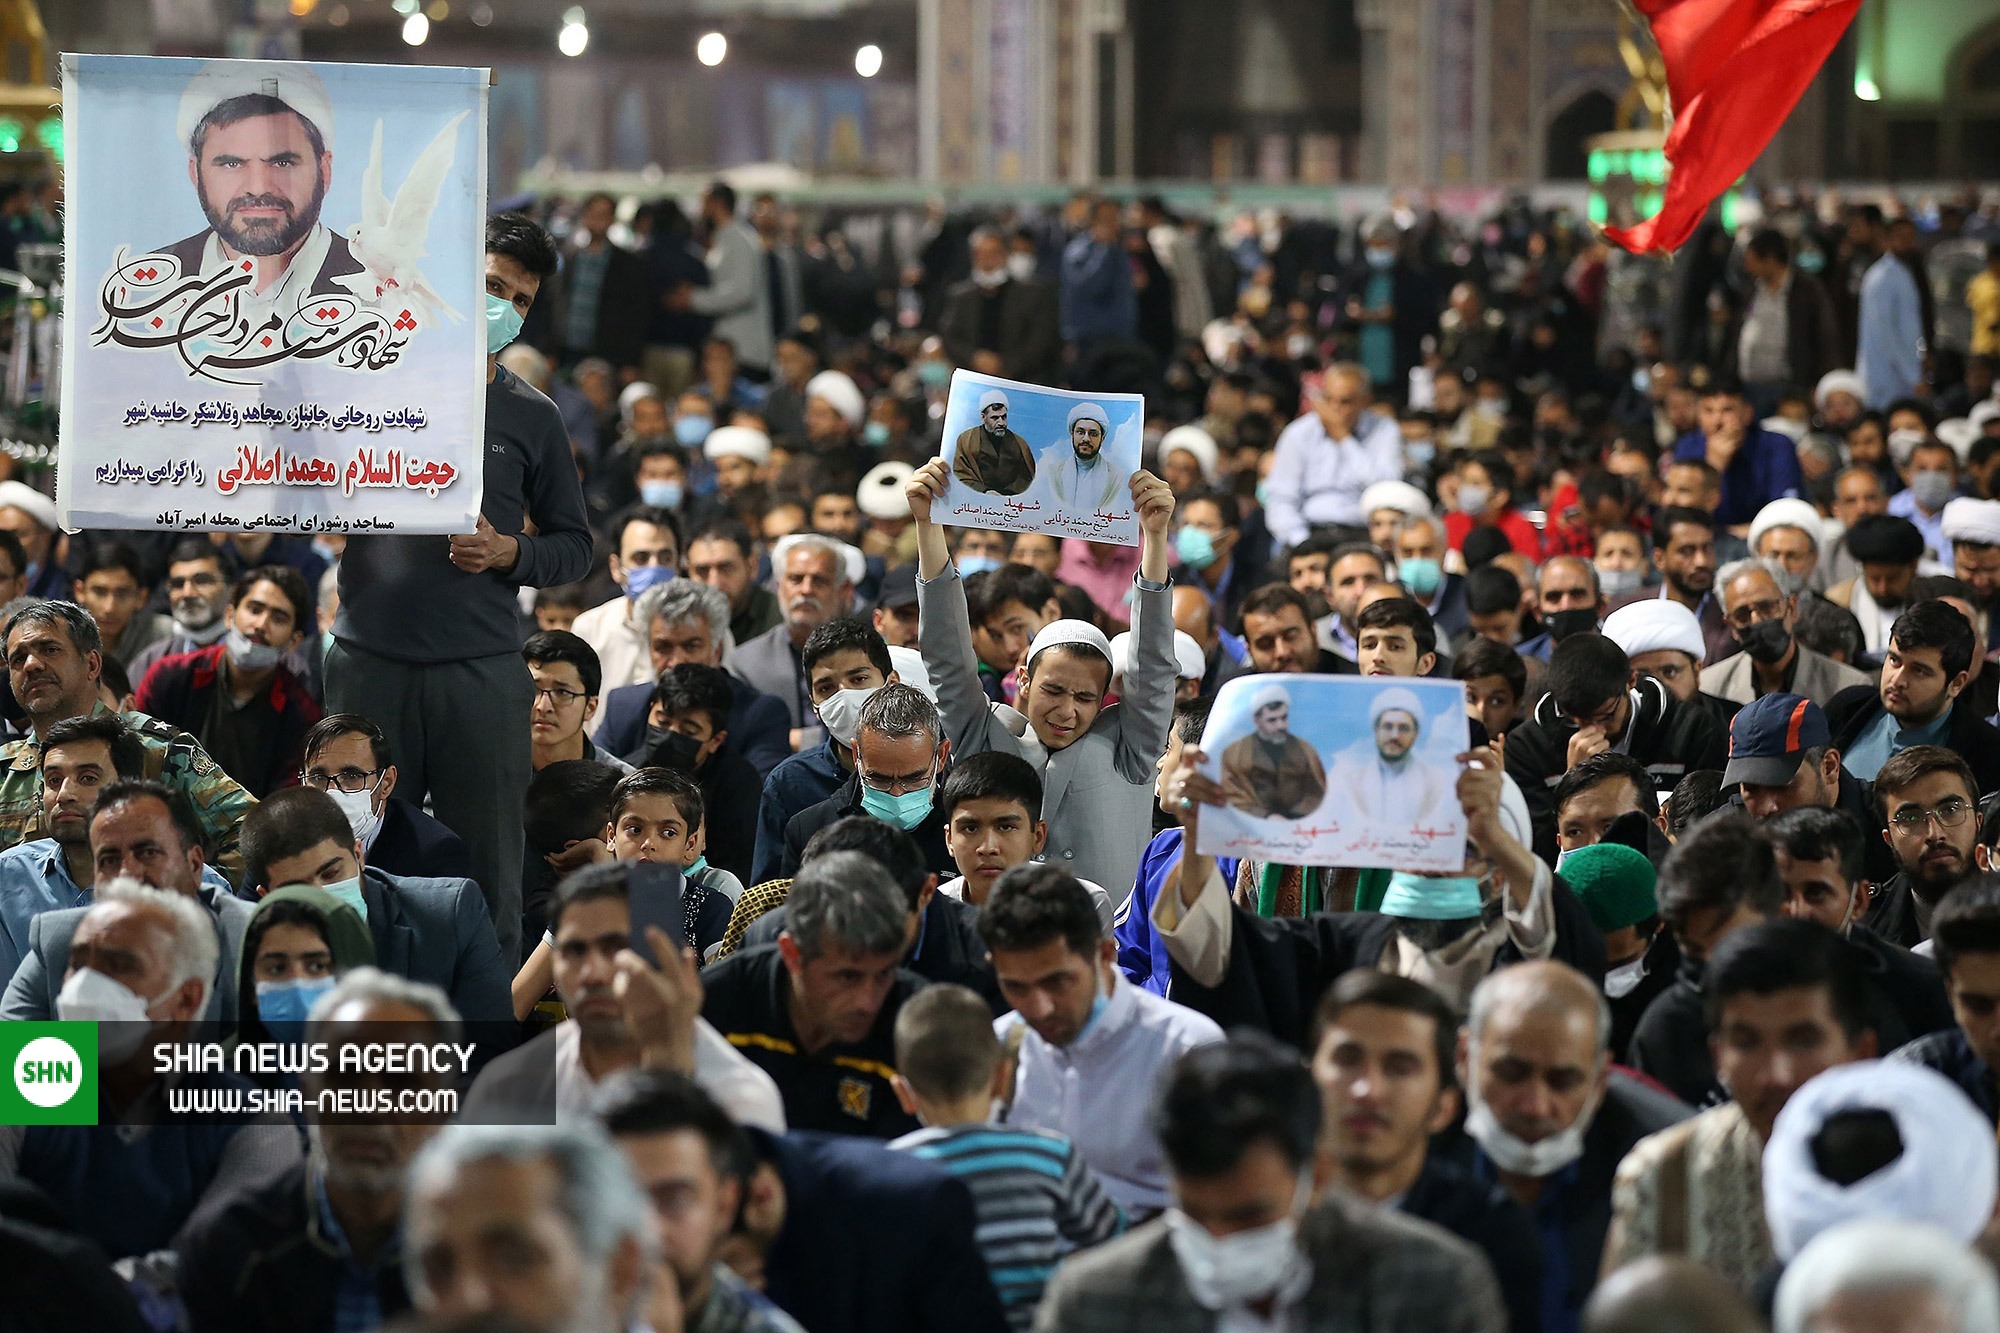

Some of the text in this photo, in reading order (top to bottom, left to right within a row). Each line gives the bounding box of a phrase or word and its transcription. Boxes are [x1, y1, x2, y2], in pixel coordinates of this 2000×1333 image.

[122, 400, 147, 423] شهر
[150, 400, 187, 422] حاشیه
[242, 402, 283, 426] مجاهد
[332, 404, 380, 429] روحانی
[383, 405, 426, 429] شهادت
[96, 444, 455, 495] حجت السلام محمد اصلانی را گرامی میداریم
[953, 503, 982, 515] اصلانی
[1004, 497, 1041, 512] شهید
[209, 511, 240, 526] محله
[243, 513, 297, 531] اجتماعی
[352, 515, 395, 532] مساجد
[1003, 511, 1019, 522] شیخ
[1093, 508, 1131, 522] شهید
[1093, 520, 1109, 532] شیخ
